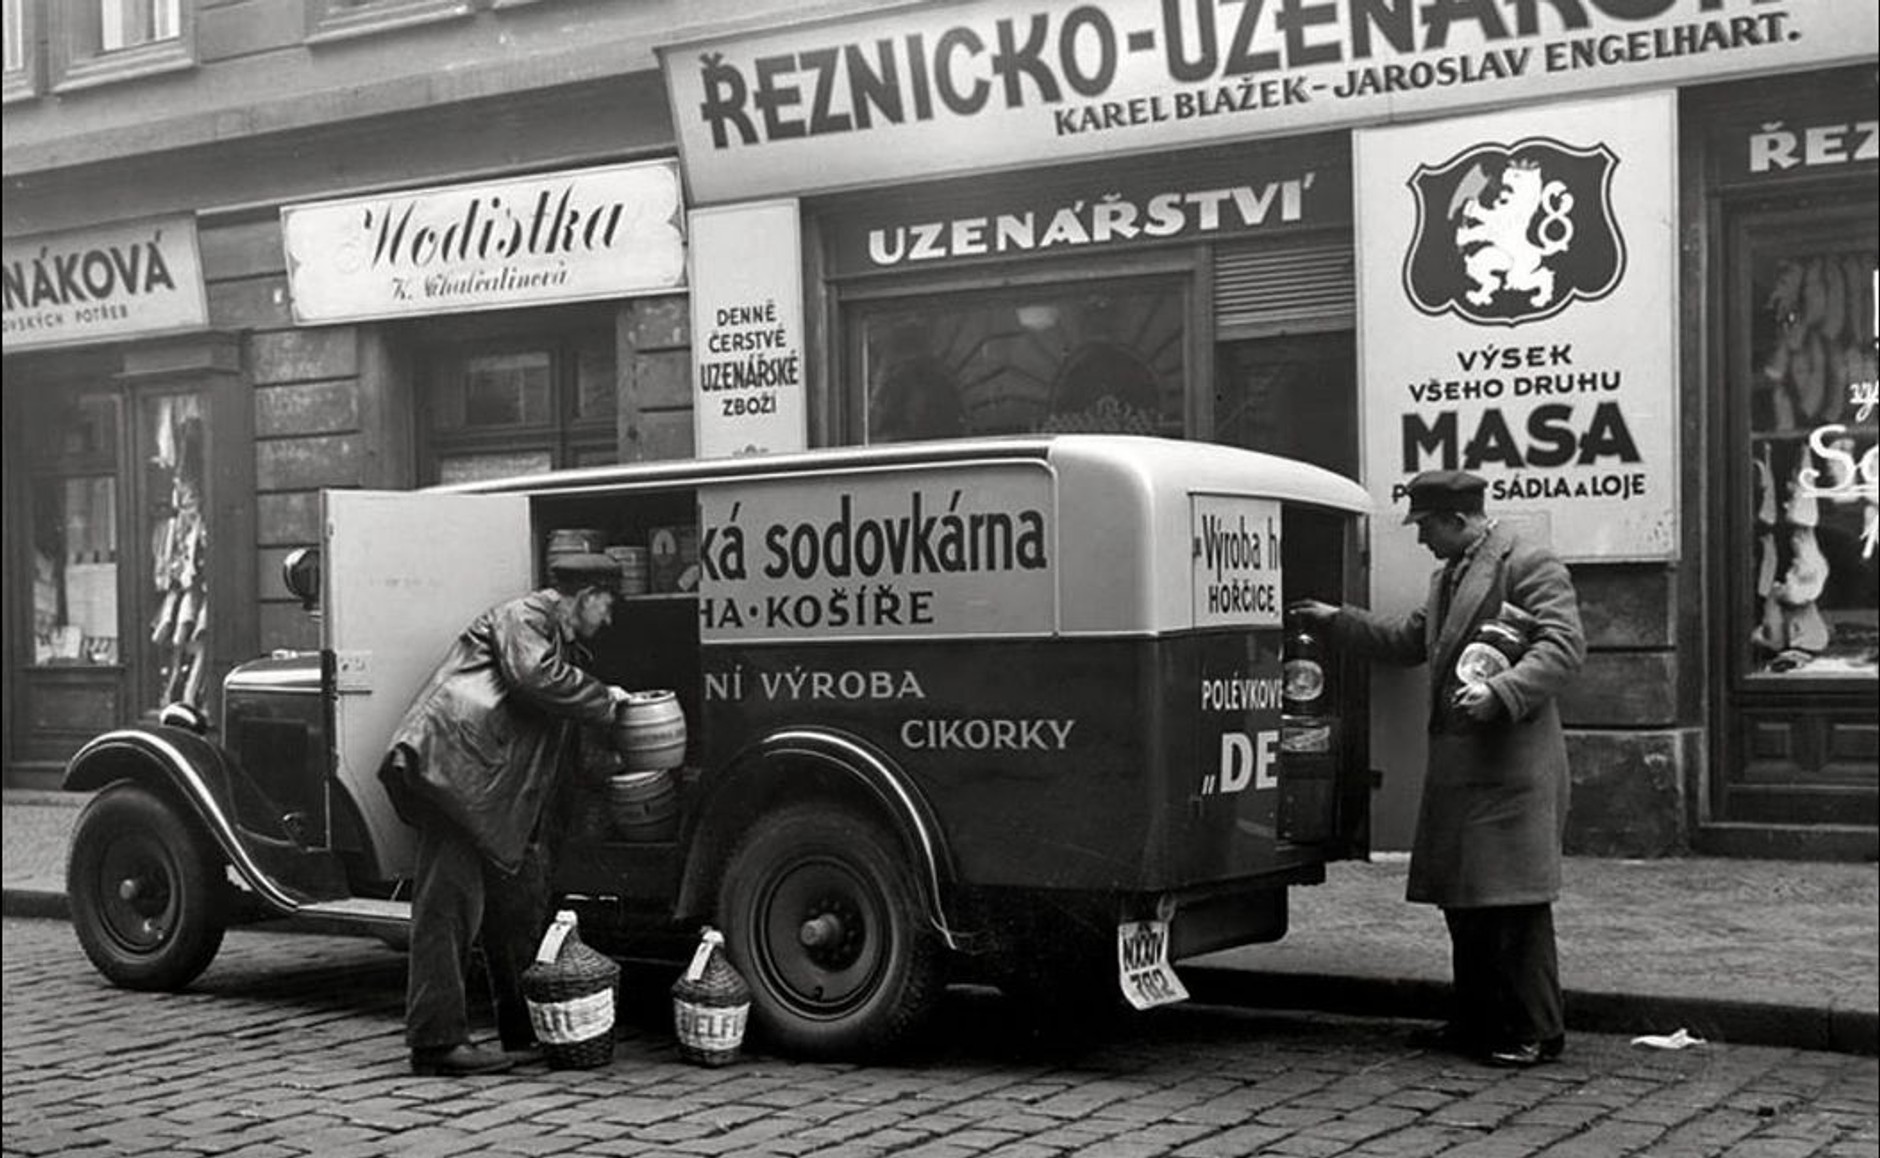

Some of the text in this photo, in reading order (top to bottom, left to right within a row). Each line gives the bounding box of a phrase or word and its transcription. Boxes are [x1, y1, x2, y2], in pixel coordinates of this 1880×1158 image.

[1054, 96, 1168, 136] KAREL
[1545, 11, 1802, 72] ENGELHART.
[1750, 120, 1879, 173] ŘEZ
[361, 183, 625, 271] Modistka
[869, 172, 1316, 266] UZENÁŘSTVÍ
[716, 299, 776, 327] DENNĚ
[709, 321, 786, 353] ČERSTVÉ
[700, 349, 799, 392] UZENÁŘSKÉ
[1456, 344, 1573, 372] VÝSEK
[722, 390, 777, 417] ZBOŽÍ
[1408, 371, 1622, 402] VŠEHO DRUHU
[1401, 400, 1642, 473] MASA
[1491, 472, 1572, 501] SÁDLA
[1591, 473, 1646, 500] LOJE
[763, 488, 1048, 580] sodovkárna
[1202, 514, 1261, 583] Výroba
[704, 664, 927, 700] NÍ VÝROBA
[900, 718, 1075, 750] CIKORKY
